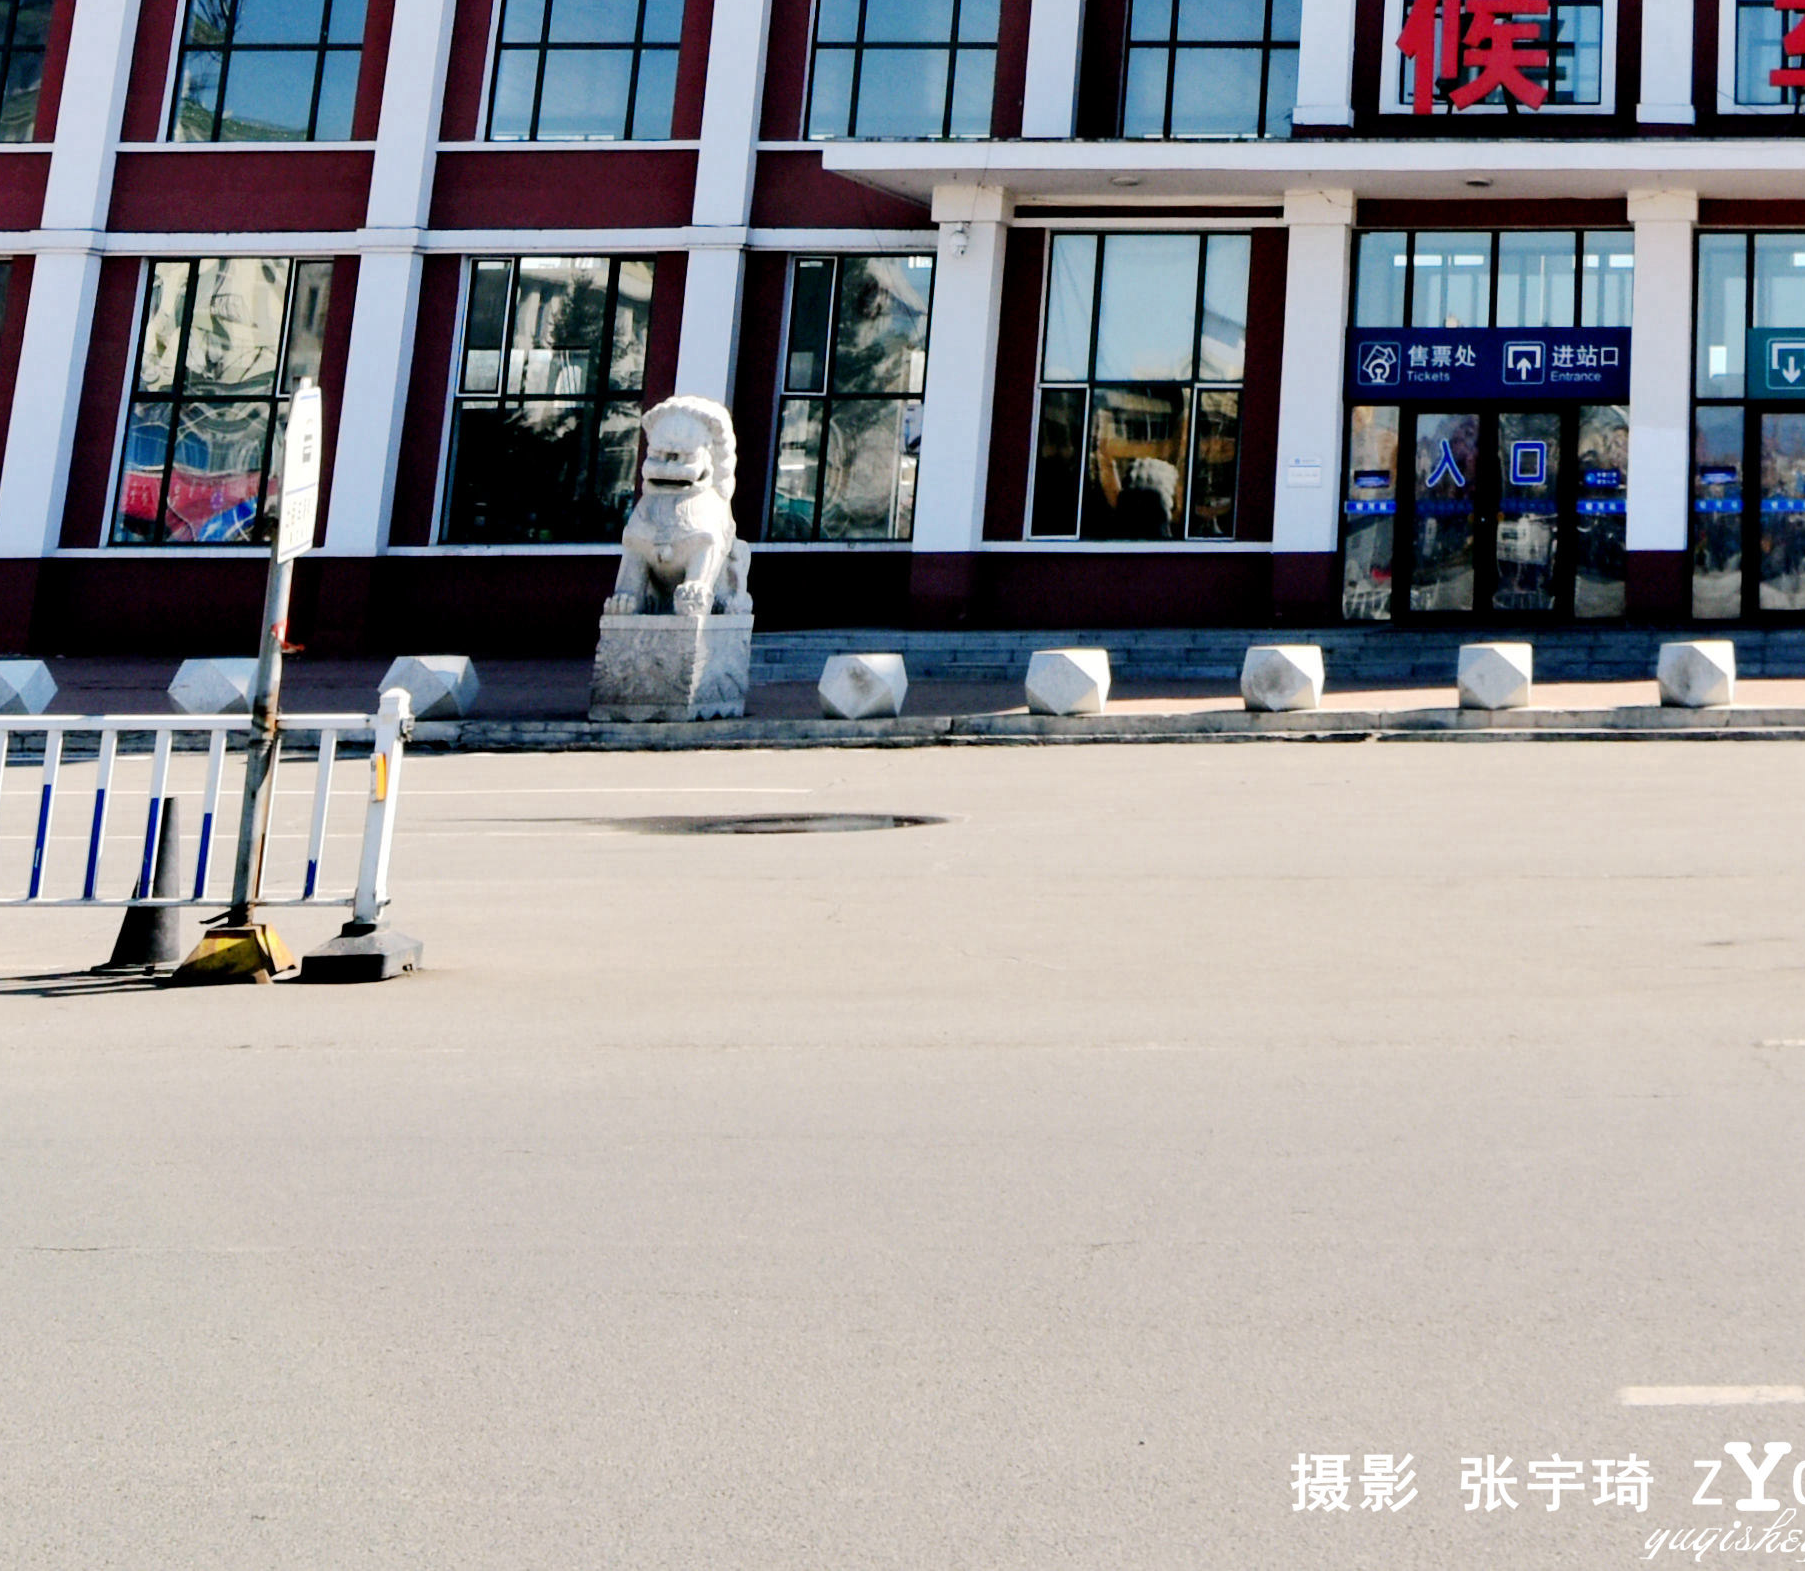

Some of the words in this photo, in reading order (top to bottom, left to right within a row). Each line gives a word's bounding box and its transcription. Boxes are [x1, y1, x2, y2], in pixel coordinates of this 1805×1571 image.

[1407, 344, 1477, 368] 售票处
[1550, 344, 1620, 368] 进站口
[1407, 370, 1451, 383] Tickets
[1550, 371, 1602, 383] Entrance
[1425, 438, 1547, 488] 入口
